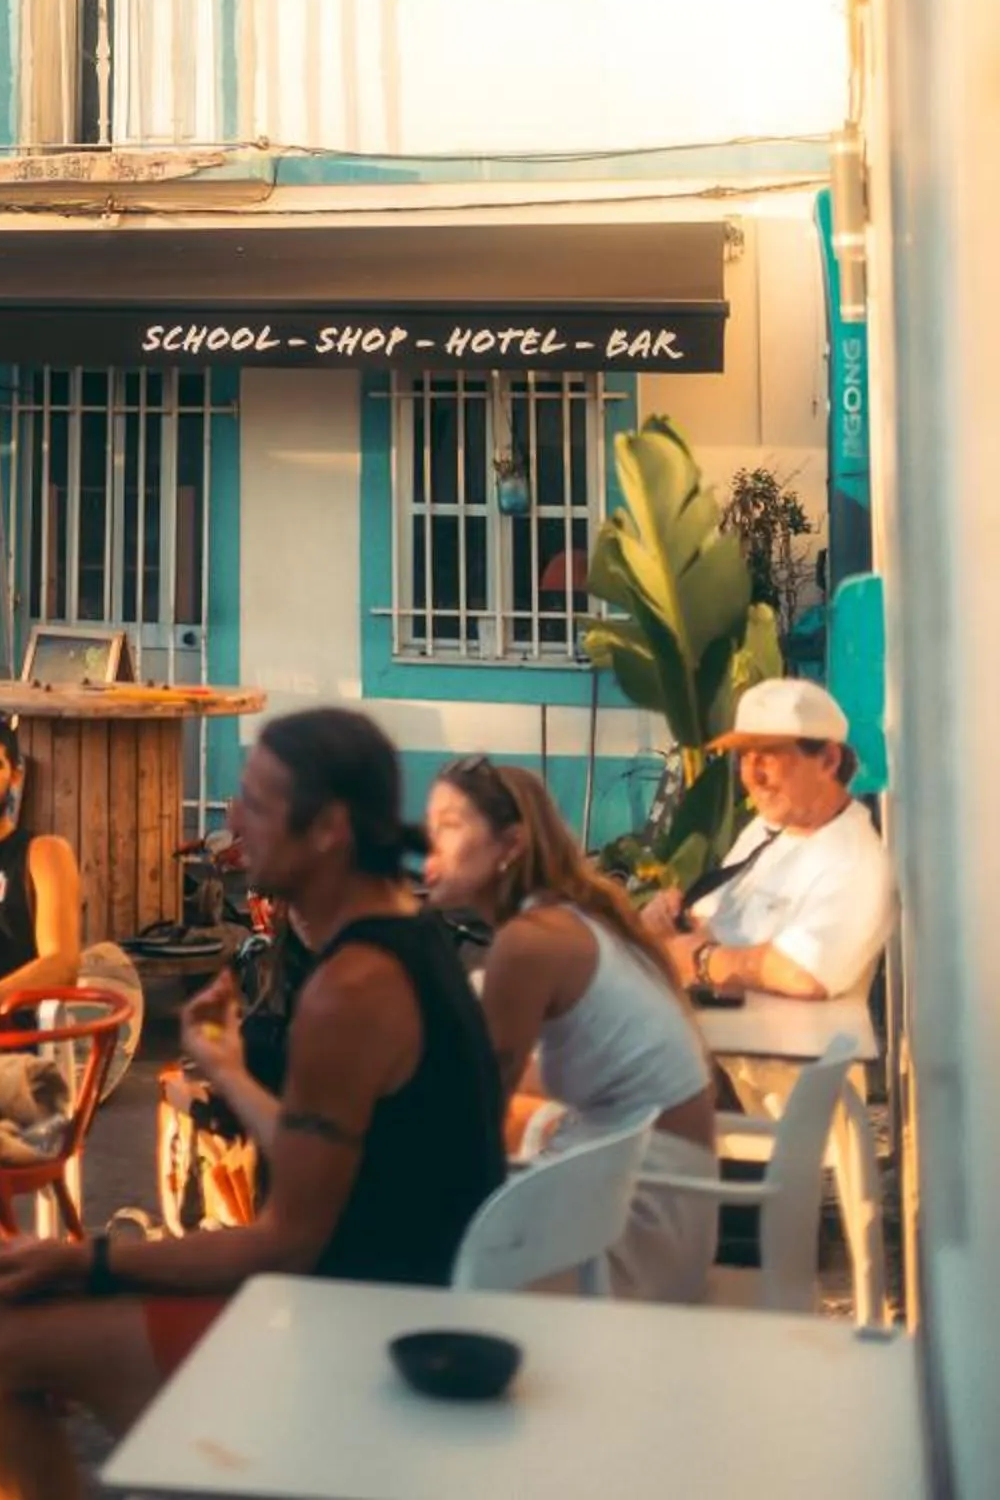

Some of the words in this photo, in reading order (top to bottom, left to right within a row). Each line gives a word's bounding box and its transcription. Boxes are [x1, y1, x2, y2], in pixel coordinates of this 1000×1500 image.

[142, 325, 280, 354] SCHOOL
[315, 326, 408, 356] SHOP
[445, 327, 566, 357] HOTEL
[605, 328, 684, 359] BAR
